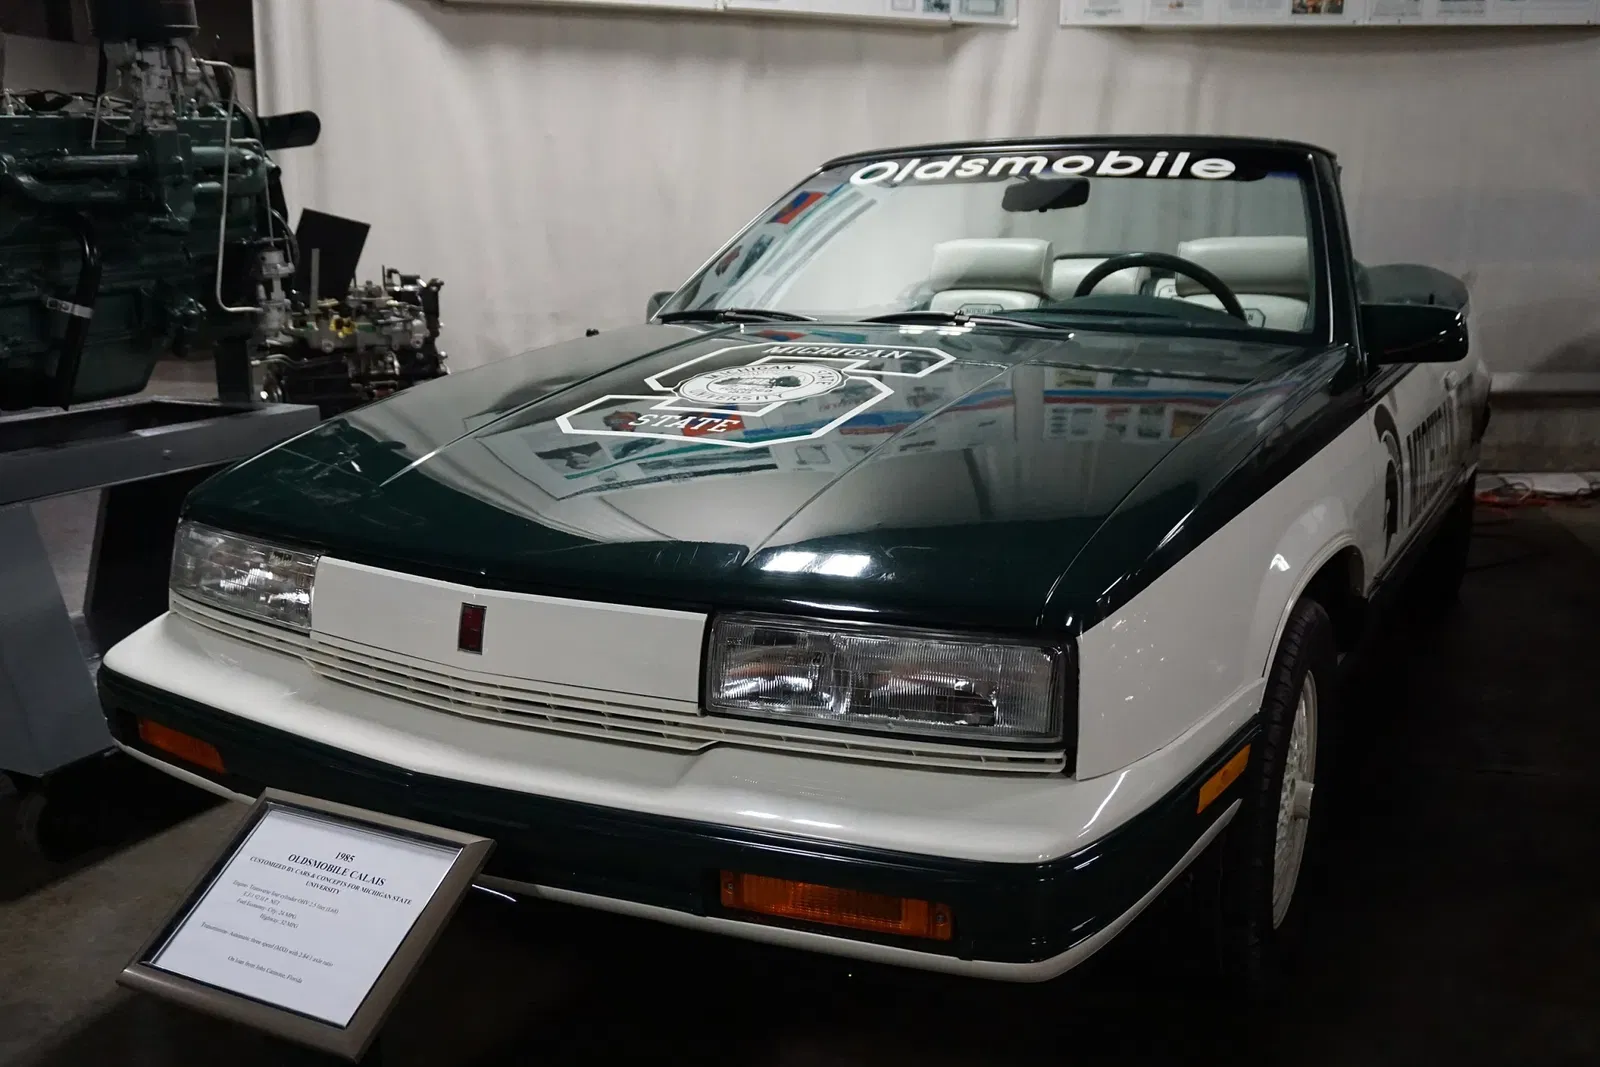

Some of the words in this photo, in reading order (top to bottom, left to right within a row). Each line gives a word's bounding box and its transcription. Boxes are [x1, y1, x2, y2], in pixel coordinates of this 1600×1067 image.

[849, 150, 1236, 183] Oldsmobile
[762, 346, 912, 359] MICHIGAN
[628, 414, 741, 432] STATE
[335, 852, 356, 863] 1985
[287, 853, 349, 877] OLDSMOBILE
[349, 870, 387, 887] CALAIS
[250, 856, 287, 871] CUSTOMIZED
[295, 868, 310, 878] CARS
[316, 874, 348, 888] CONCEPTS
[347, 882, 361, 891] FOR
[360, 886, 391, 900] MICHIGAN
[391, 895, 413, 905] STATE
[305, 881, 340, 895] UNIVERSITY
[284, 911, 297, 920] MPG
[286, 920, 299, 929] MPG
